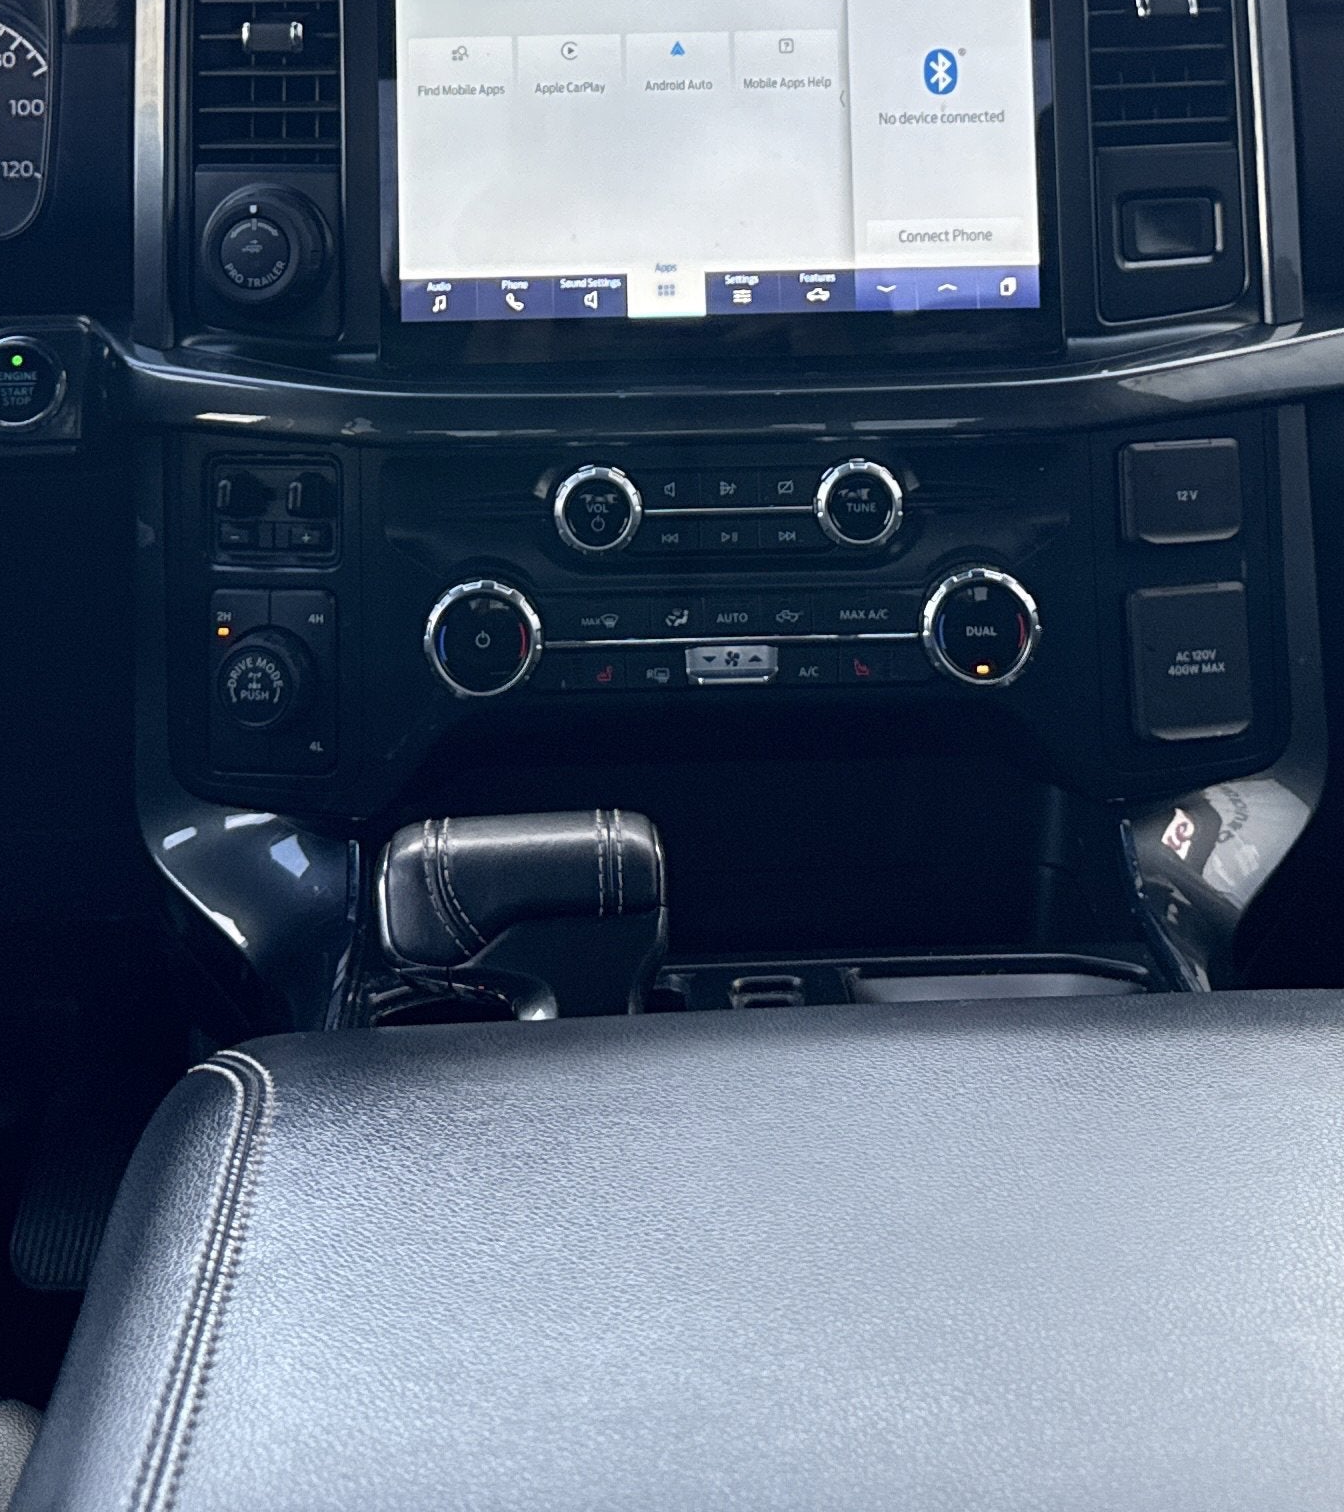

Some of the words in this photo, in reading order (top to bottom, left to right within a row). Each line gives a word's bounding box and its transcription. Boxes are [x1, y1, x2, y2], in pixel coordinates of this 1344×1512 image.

[534, 82, 565, 94] Apple
[566, 81, 606, 94] CarPlay
[645, 80, 685, 92] Android
[687, 79, 713, 91] Auto
[743, 76, 777, 89] Mobile
[780, 76, 806, 90] Apps
[808, 75, 832, 89] Help
[417, 85, 441, 96] Find
[443, 83, 476, 96] Mobile
[478, 84, 505, 97] Apps
[9, 99, 45, 116] 100
[879, 112, 897, 125] No
[899, 111, 937, 124] device
[940, 110, 1005, 124] connected
[1, 161, 34, 178] 120
[898, 229, 950, 243] Connect
[952, 228, 993, 242] Phone
[224, 263, 244, 284] PRO
[247, 260, 286, 288] TRAILER
[655, 263, 677, 274] Apps
[560, 278, 587, 289] Sound
[588, 277, 622, 289] Settings
[724, 274, 759, 286] Settings
[799, 272, 836, 284] Features
[426, 281, 451, 292] Audio
[501, 279, 528, 290] Phone
[0, 387, 35, 396] START
[2, 396, 32, 406] STOP
[1176, 491, 1188, 501] 12
[585, 502, 610, 514] VOL
[846, 502, 877, 514] TUNE
[216, 611, 232, 622] 2H
[308, 614, 324, 624] 4H
[716, 612, 748, 623] AUTO
[840, 609, 866, 620] MAX
[868, 609, 889, 620] A/C
[966, 625, 998, 637] DUAL
[1176, 651, 1190, 662] AC
[1192, 649, 1216, 661] 120V
[227, 657, 254, 688] DRIVE
[256, 657, 284, 688] MODE
[799, 665, 819, 678] A/C
[1201, 662, 1225, 674] MAX
[240, 689, 269, 701] PUSH
[309, 741, 323, 752] 4L
